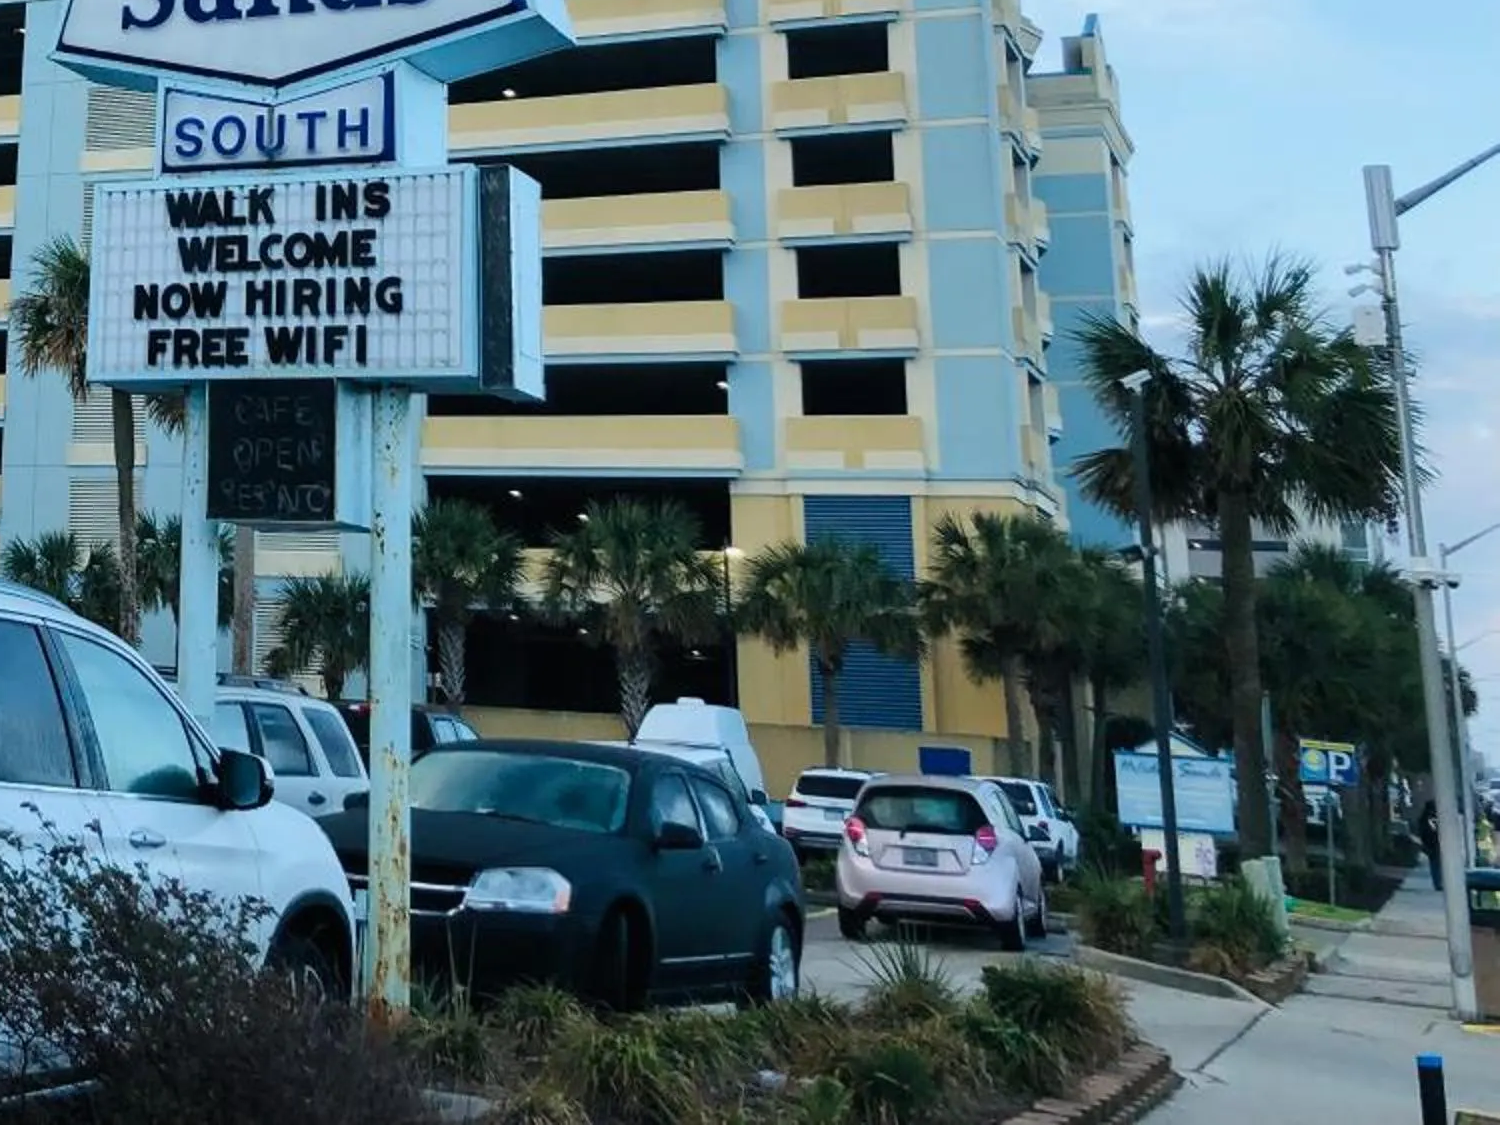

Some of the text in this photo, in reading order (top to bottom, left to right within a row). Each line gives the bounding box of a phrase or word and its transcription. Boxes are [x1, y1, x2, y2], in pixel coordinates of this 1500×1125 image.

[175, 108, 370, 158] SOUTH
[165, 182, 391, 229] WALK INS
[177, 229, 377, 274] WELCOME
[133, 276, 403, 321] NOW HIRING
[147, 324, 367, 367] FREE WIFI
[233, 436, 322, 473] OPEN
[1328, 751, 1351, 781] P
